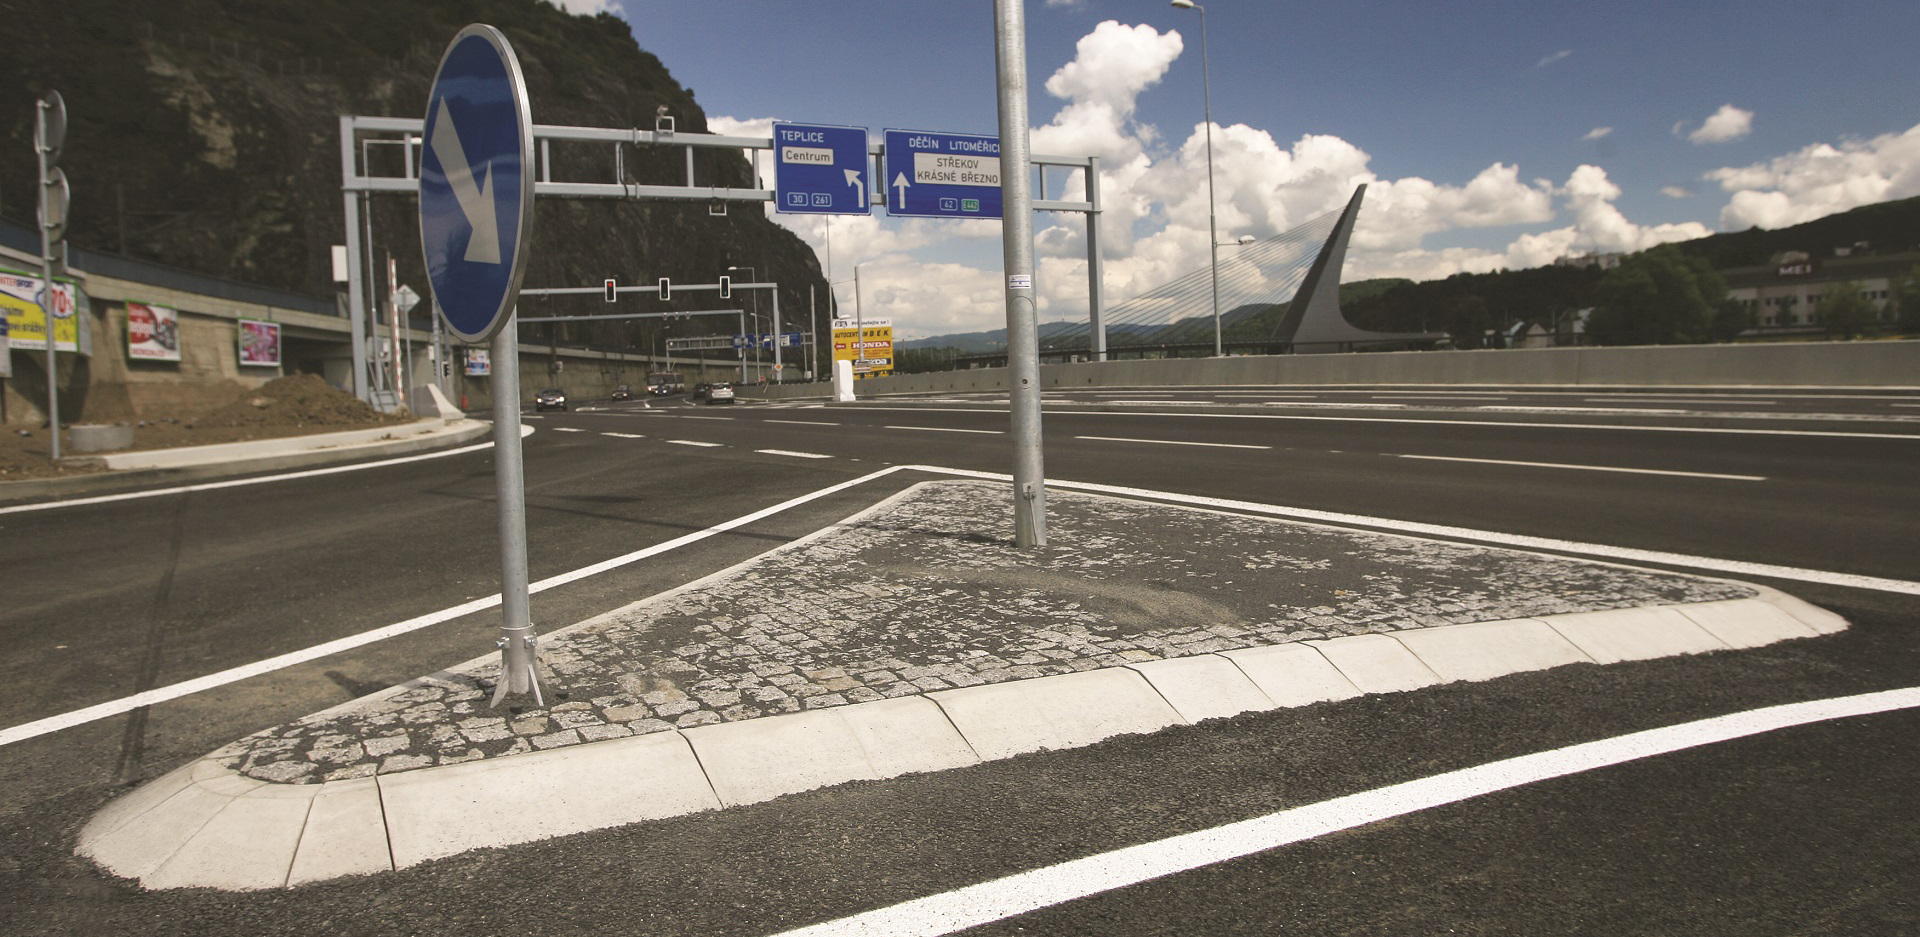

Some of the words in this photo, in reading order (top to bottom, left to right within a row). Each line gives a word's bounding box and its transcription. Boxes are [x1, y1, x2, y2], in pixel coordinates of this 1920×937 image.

[781, 130, 824, 142] TEPLICE
[909, 136, 939, 149] DĚČÍN
[786, 150, 830, 161] Centrum
[937, 156, 979, 168] STŘEKOV
[917, 169, 956, 182] KRÁSNÉ
[961, 171, 998, 183] BŘEZNO
[793, 195, 803, 203] 30
[815, 196, 828, 204] 261
[944, 200, 953, 208] 62
[963, 201, 978, 209] E442
